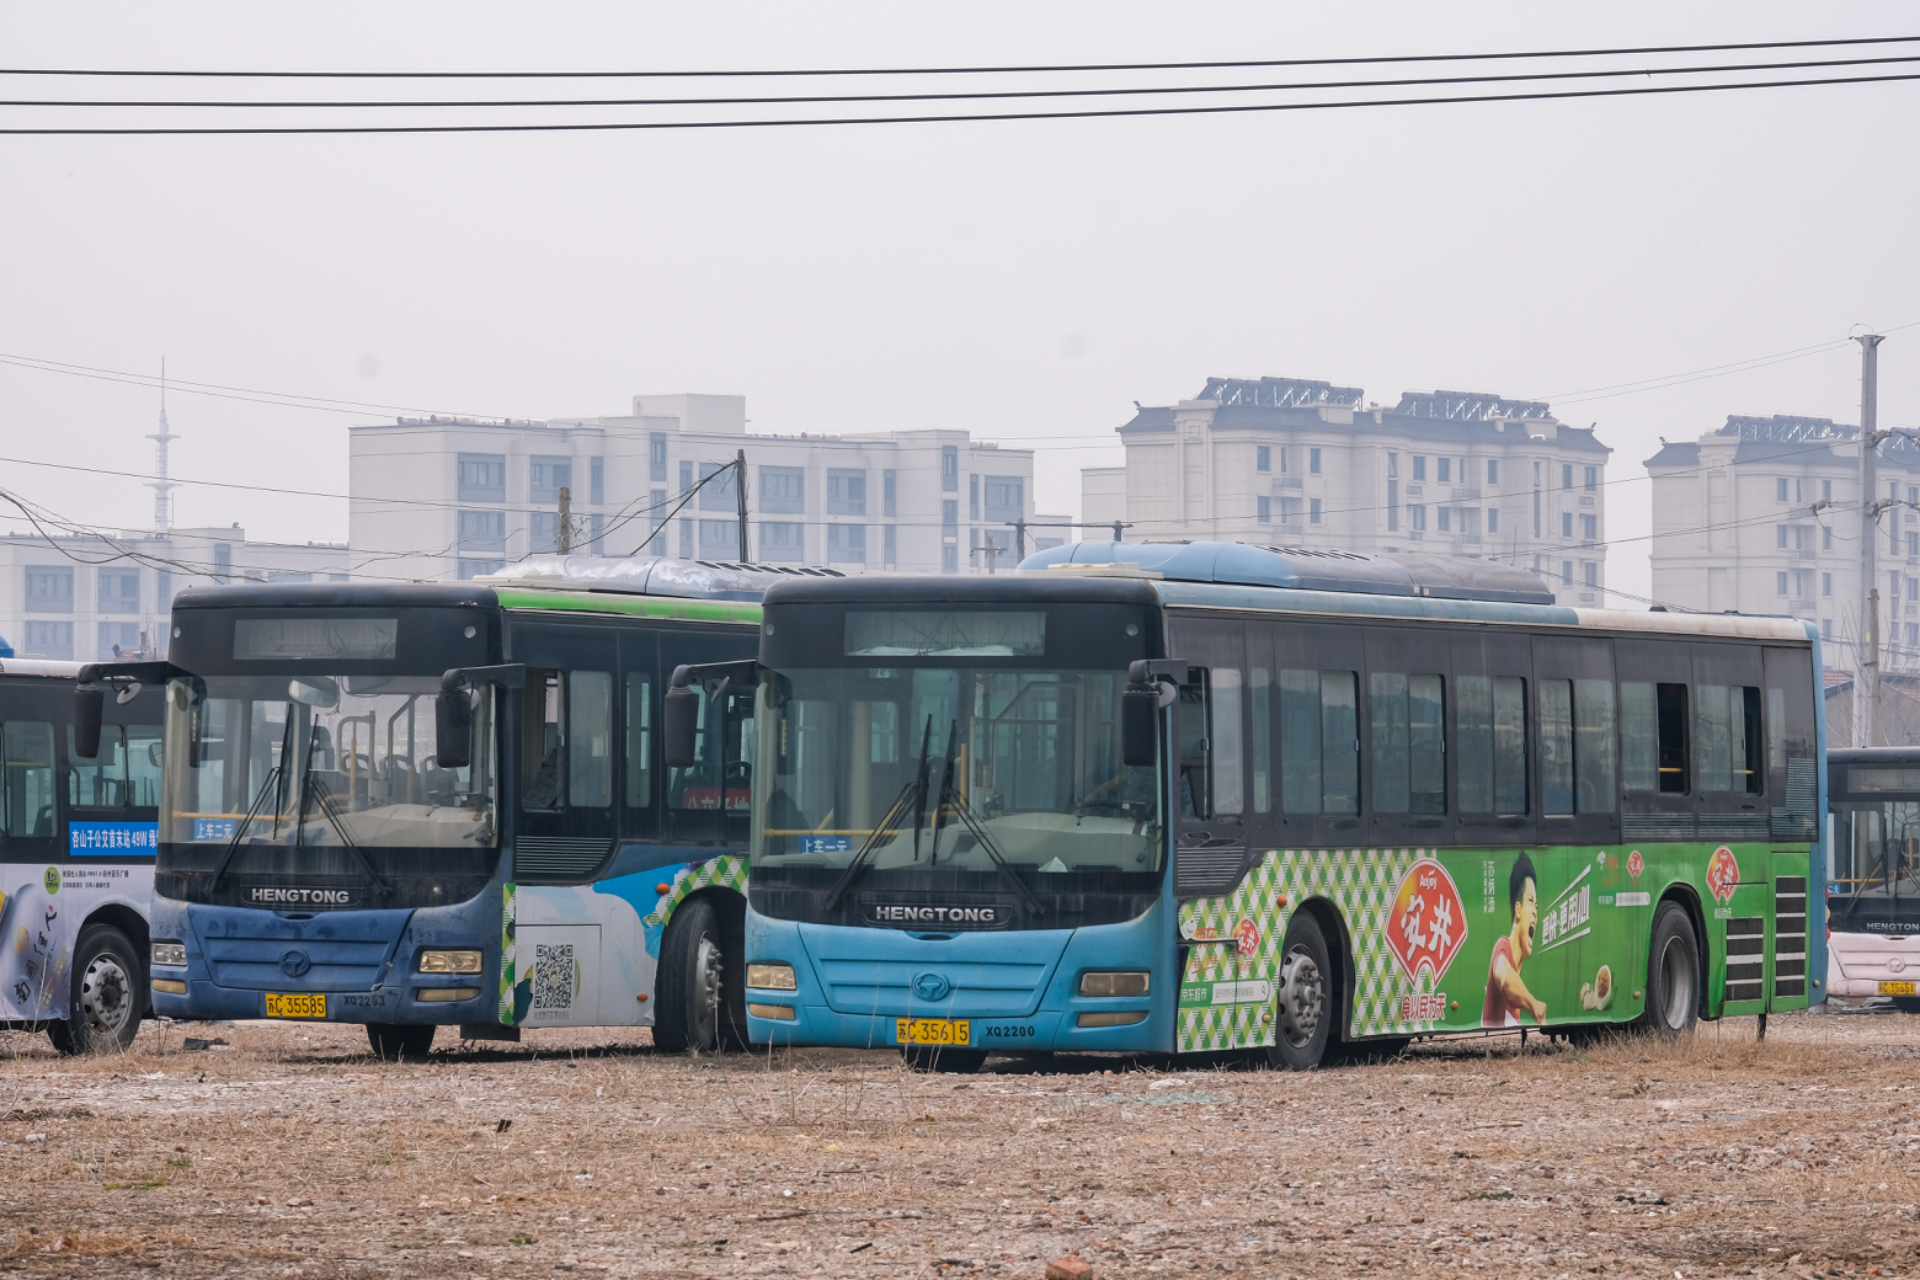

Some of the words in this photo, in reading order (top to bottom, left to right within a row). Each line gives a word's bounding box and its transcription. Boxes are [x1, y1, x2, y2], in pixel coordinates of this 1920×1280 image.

[196, 823, 233, 839] 上车二元
[251, 888, 349, 903] HENGTONG
[876, 906, 995, 921] HENGTONG
[1401, 894, 1452, 961] 安井
[1866, 922, 1920, 931] HENGTON
[1402, 995, 1446, 1020] 食以民为天
[986, 1026, 1035, 1037] XQ2200
